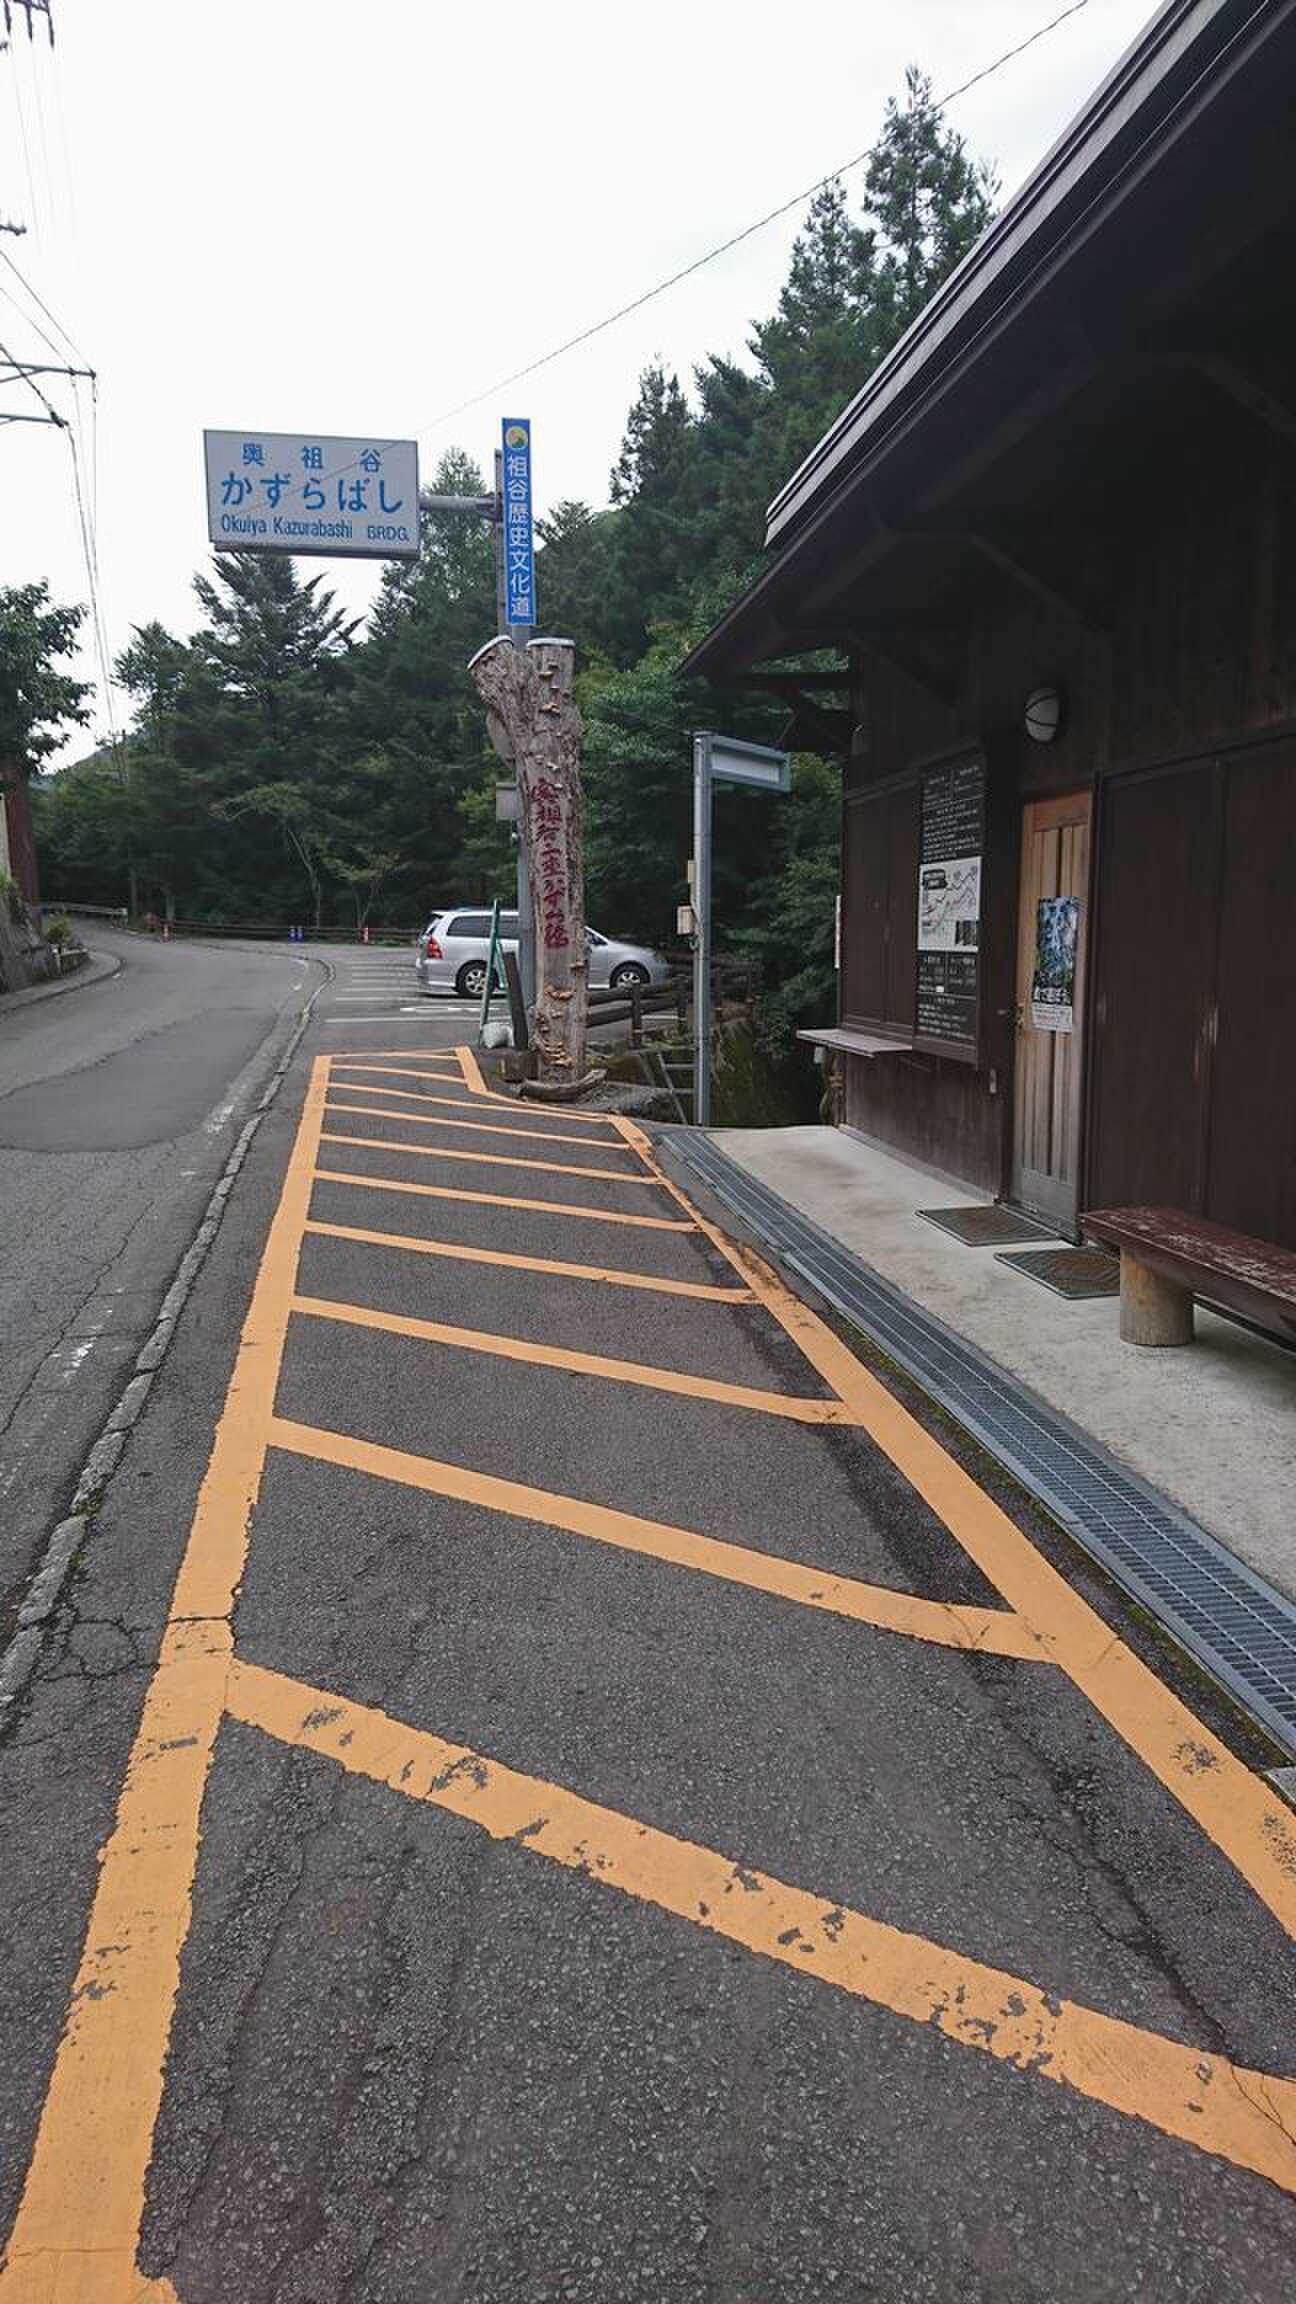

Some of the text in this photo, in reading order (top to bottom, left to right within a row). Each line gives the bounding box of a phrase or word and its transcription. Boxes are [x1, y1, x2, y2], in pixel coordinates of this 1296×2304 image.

[242, 442, 383, 473] 奥祖谷
[220, 471, 404, 514] かずらばし
[221, 513, 267, 537] Okuiya
[273, 516, 353, 539] Kazurabashi
[507, 455, 530, 618] 祖谷歴史文化道
